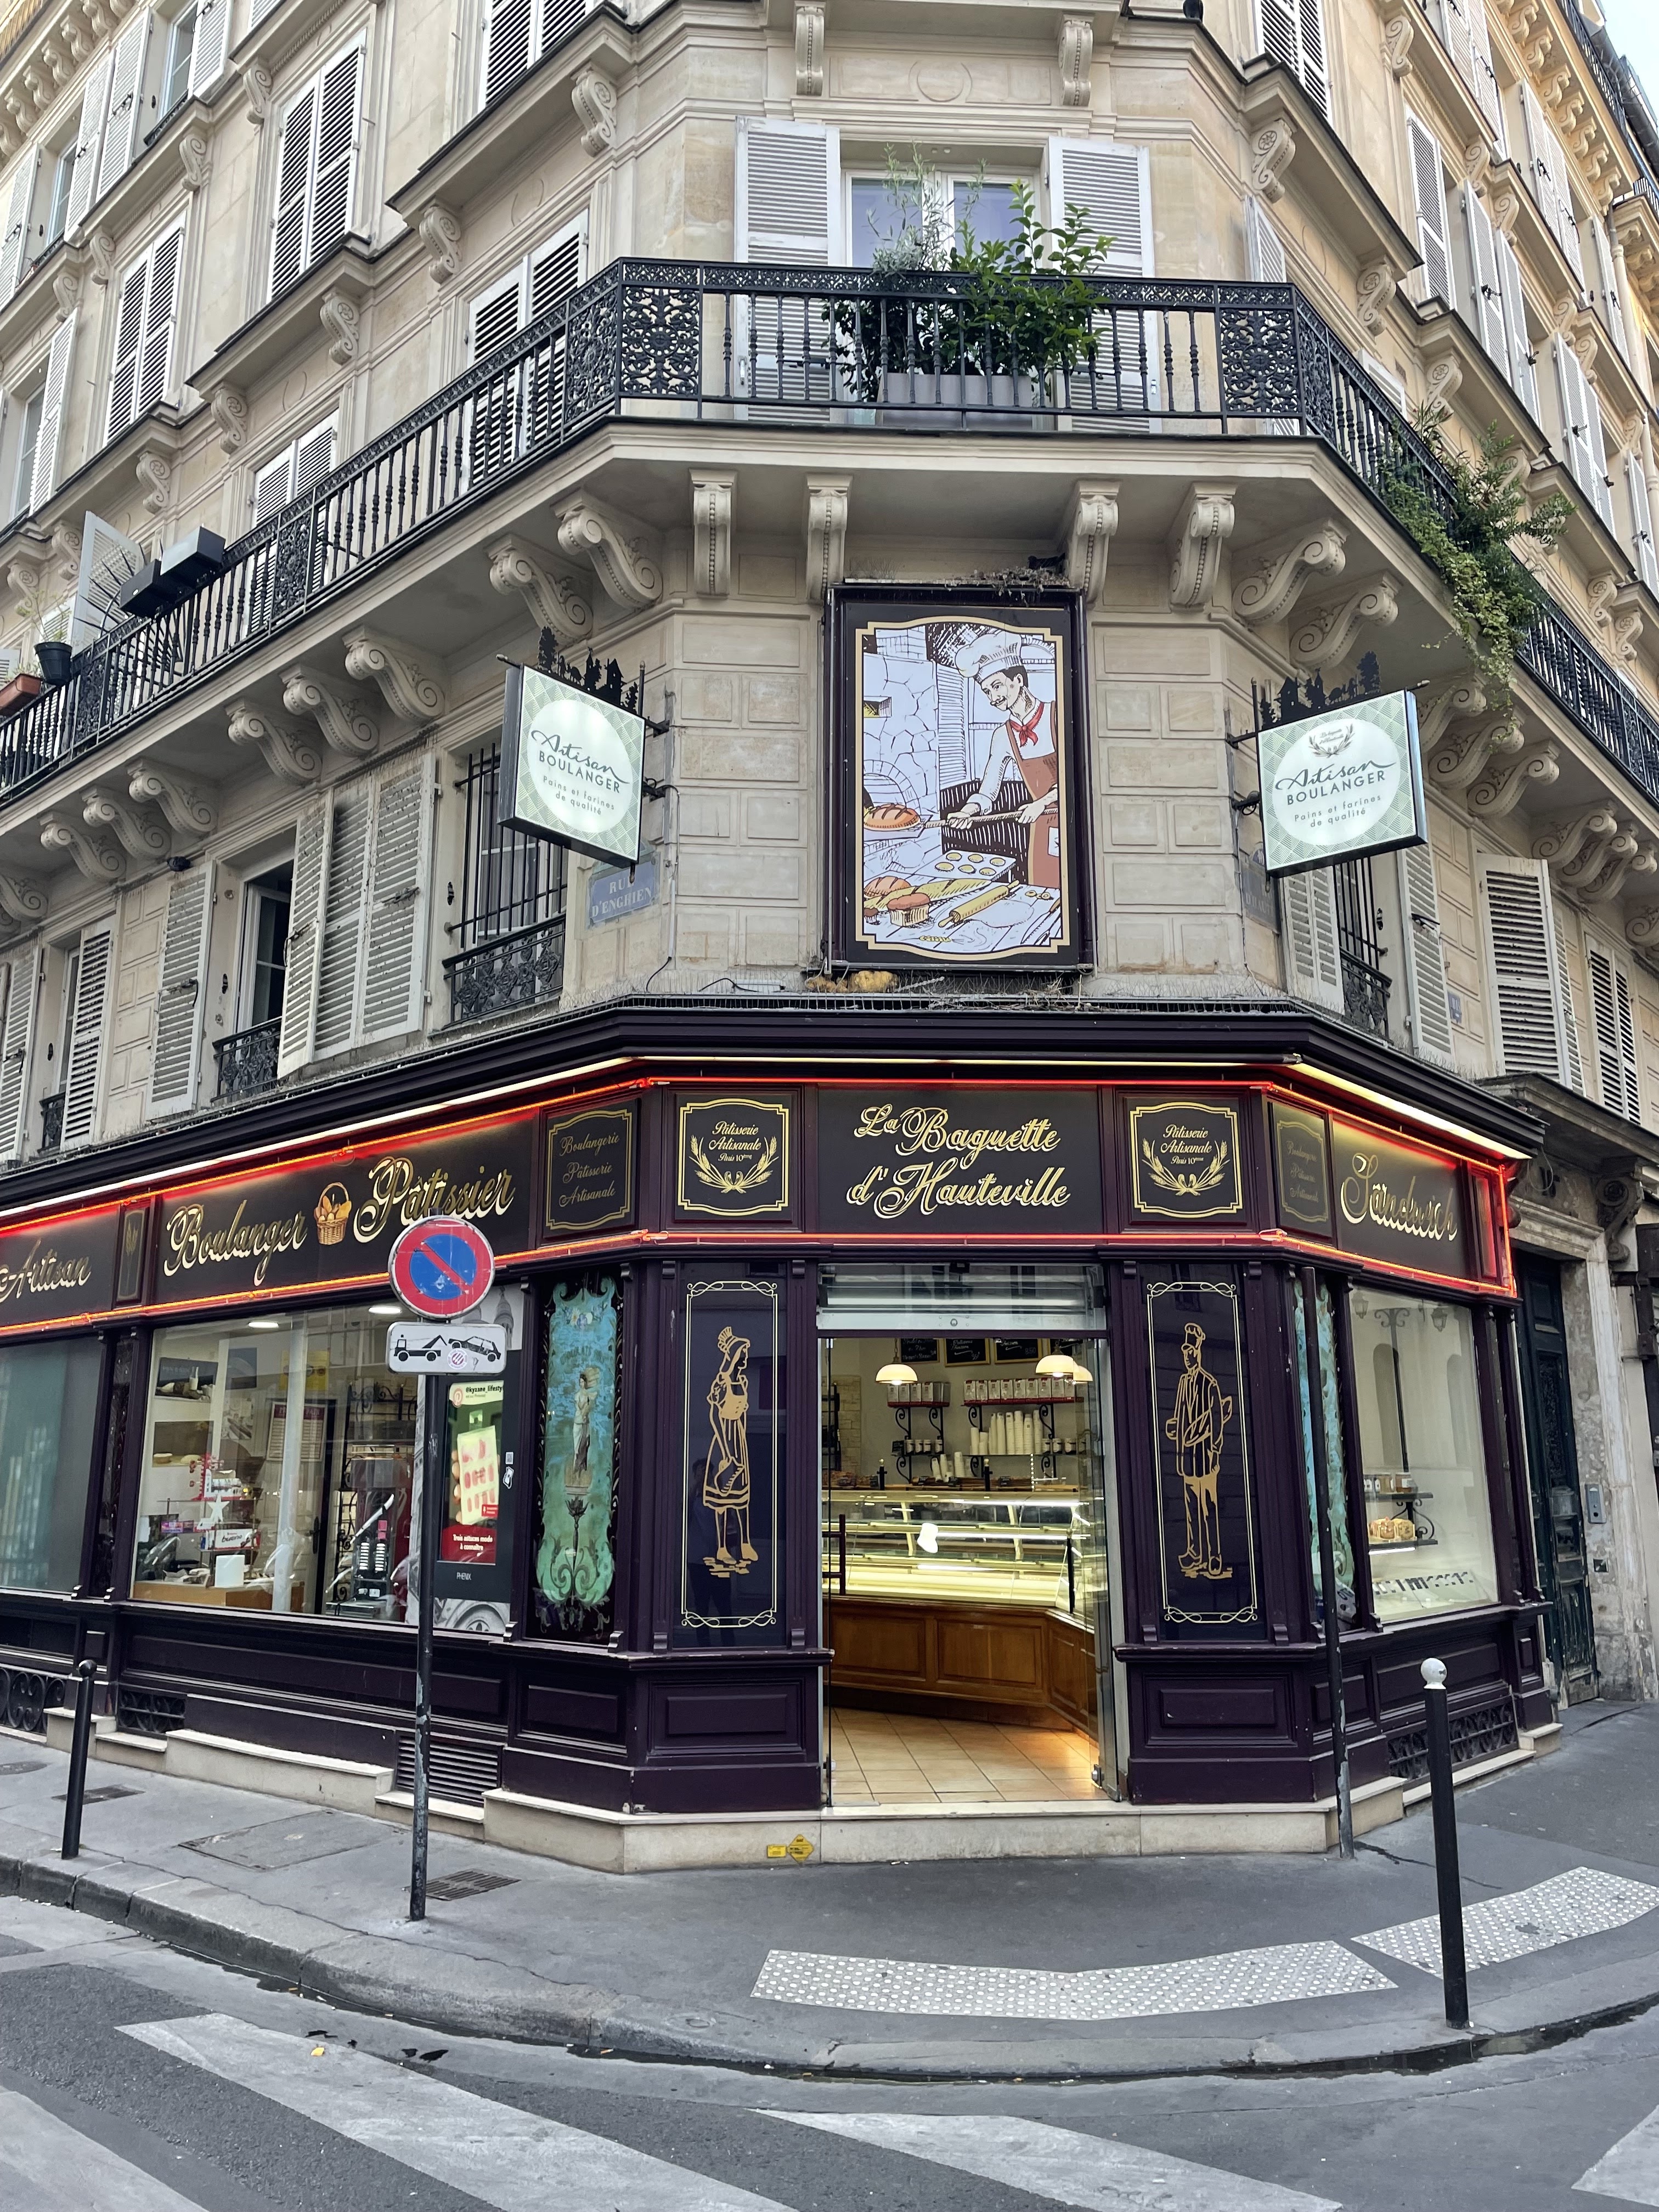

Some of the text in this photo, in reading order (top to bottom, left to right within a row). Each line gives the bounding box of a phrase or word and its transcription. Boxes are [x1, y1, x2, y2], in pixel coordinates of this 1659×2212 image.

[531, 730, 630, 784] Artisan
[539, 751, 620, 793] BOULANGER
[1275, 760, 1396, 790] Artisan
[543, 776, 567, 792] Pains
[584, 791, 614, 810] farines
[1287, 770, 1385, 805] BOULANGER
[555, 791, 601, 815] de qualité
[1295, 795, 1381, 822] Pains et farines
[1311, 809, 1366, 828] de qualité
[592, 887, 652, 917] D'ENGHIEN
[712, 1121, 759, 1135] Pâtisserie
[854, 1103, 1061, 1170] La Baguette
[1163, 1124, 1209, 1138] Pâtisserie
[559, 1132, 619, 1156] Boulangerie
[709, 1136, 761, 1150] Artisanale
[1160, 1139, 1212, 1153] Artisanale
[718, 1153, 735, 1161] Paris
[1171, 1155, 1187, 1164] Paris
[562, 1161, 613, 1183] Pâtisserie
[558, 1180, 616, 1207] Artisanale
[846, 1156, 1071, 1219] d'Hauteville
[1340, 1152, 1457, 1242] Sandwich
[164, 1156, 515, 1286] Boulanger Pâtissier
[0, 1237, 92, 1303] Artisan
[222, 1534, 242, 1543] bueno
[456, 1572, 472, 1581] PHENIX
